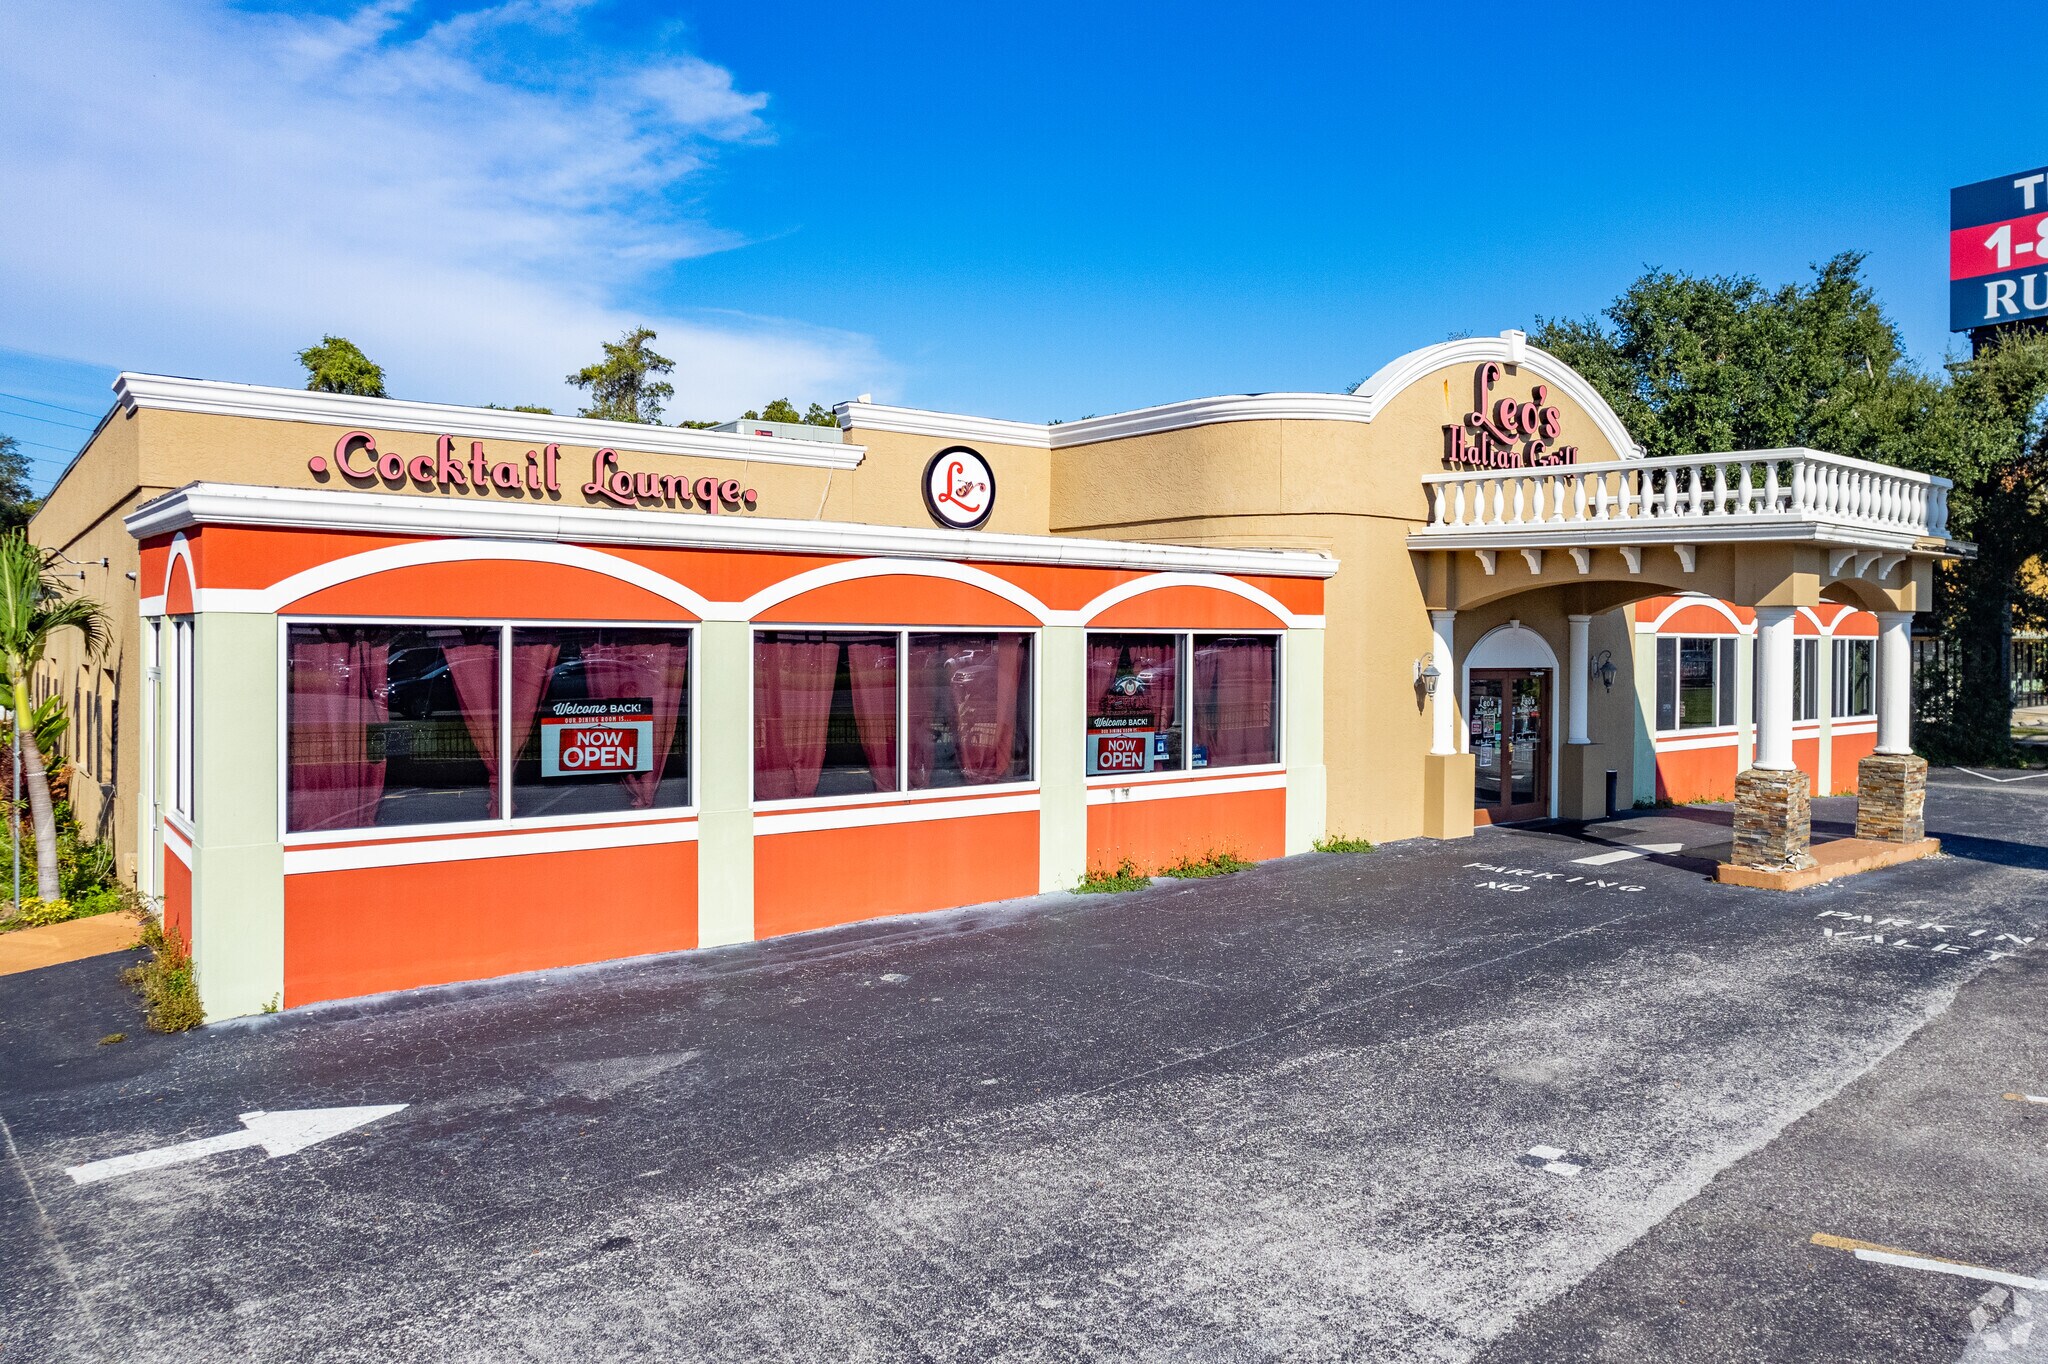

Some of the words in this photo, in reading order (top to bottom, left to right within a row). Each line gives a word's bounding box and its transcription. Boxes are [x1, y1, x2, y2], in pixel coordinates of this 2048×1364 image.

[2014, 173, 2048, 210] T
[1470, 361, 1561, 446] Leo's
[1447, 424, 1522, 469] Italian
[334, 431, 562, 492] Cocktail
[584, 447, 744, 515] Lounge
[552, 702, 608, 715] Welcome
[609, 703, 642, 713] BACK!
[1094, 717, 1128, 728] Welcome
[1128, 718, 1148, 726] BACK!
[576, 731, 623, 746] NOW
[1108, 740, 1137, 752] NOW
[562, 746, 635, 768] OPEN
[1099, 751, 1143, 768] OPEN
[1462, 862, 1647, 892] PARKING
[1474, 881, 1531, 892] NO
[1815, 910, 2048, 948] PARKIN
[1823, 927, 2018, 961] VALET
